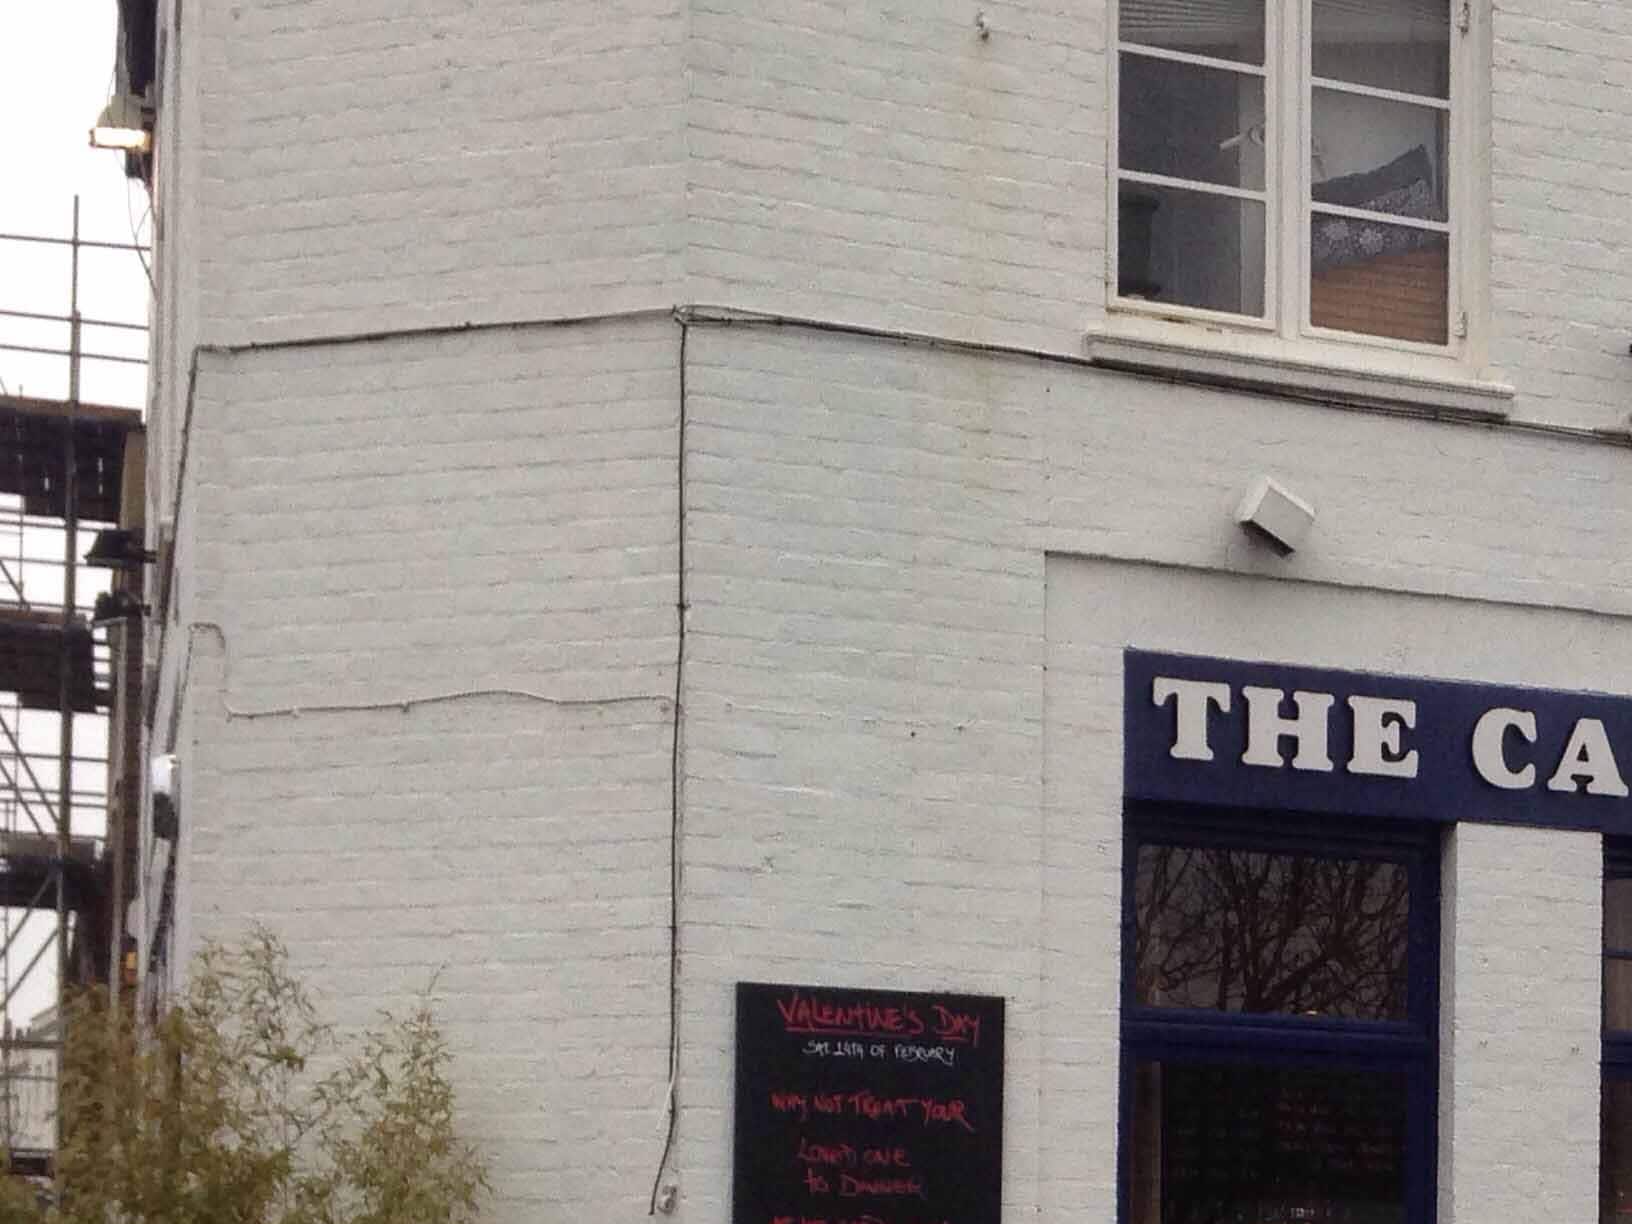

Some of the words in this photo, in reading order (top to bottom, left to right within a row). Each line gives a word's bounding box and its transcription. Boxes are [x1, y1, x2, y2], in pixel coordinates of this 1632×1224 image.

[1152, 676, 1419, 778] THE
[777, 994, 925, 1034] VALENTINE'S
[931, 1003, 980, 1047] DAY
[870, 1045, 885, 1059] OF
